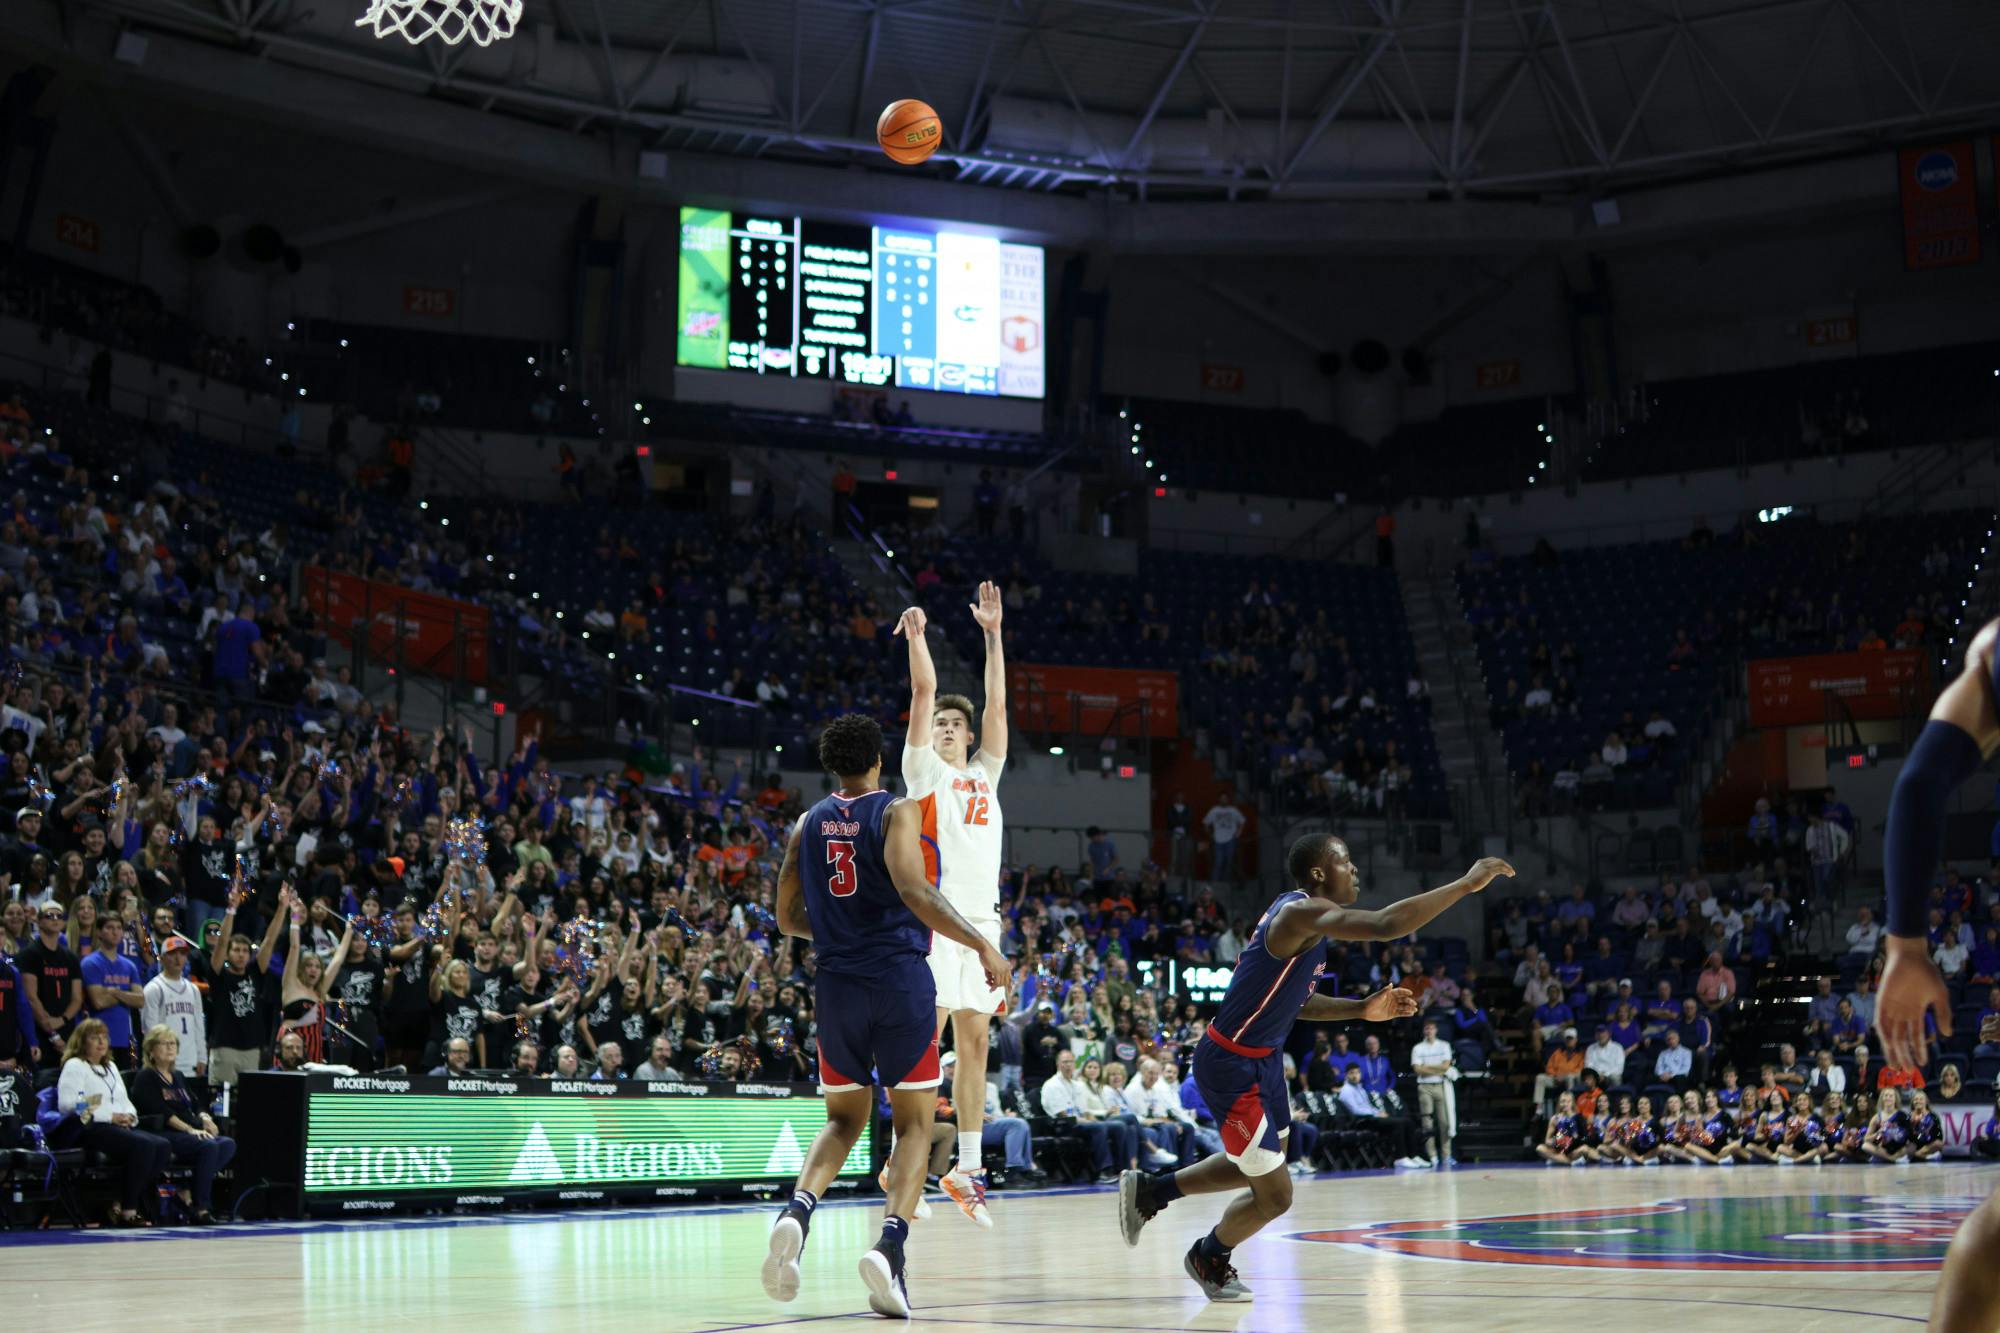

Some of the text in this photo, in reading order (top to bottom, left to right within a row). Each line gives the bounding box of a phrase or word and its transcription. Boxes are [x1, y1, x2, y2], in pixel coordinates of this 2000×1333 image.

[1849, 754, 1863, 768] EXIT
[963, 796, 989, 825] 12
[821, 821, 860, 837] ROSADO
[827, 840, 857, 897] 3
[181, 1016, 187, 1034] 1
[333, 1077, 410, 1093] ROCKET Mortgage
[448, 1079, 517, 1094] ROCKET Mortgage
[551, 1081, 617, 1095] ROCKET Mortgage
[648, 1081, 679, 1093] ROCKET
[577, 1132, 723, 1180] REGIONS
[343, 1200, 370, 1210] ROCKET
